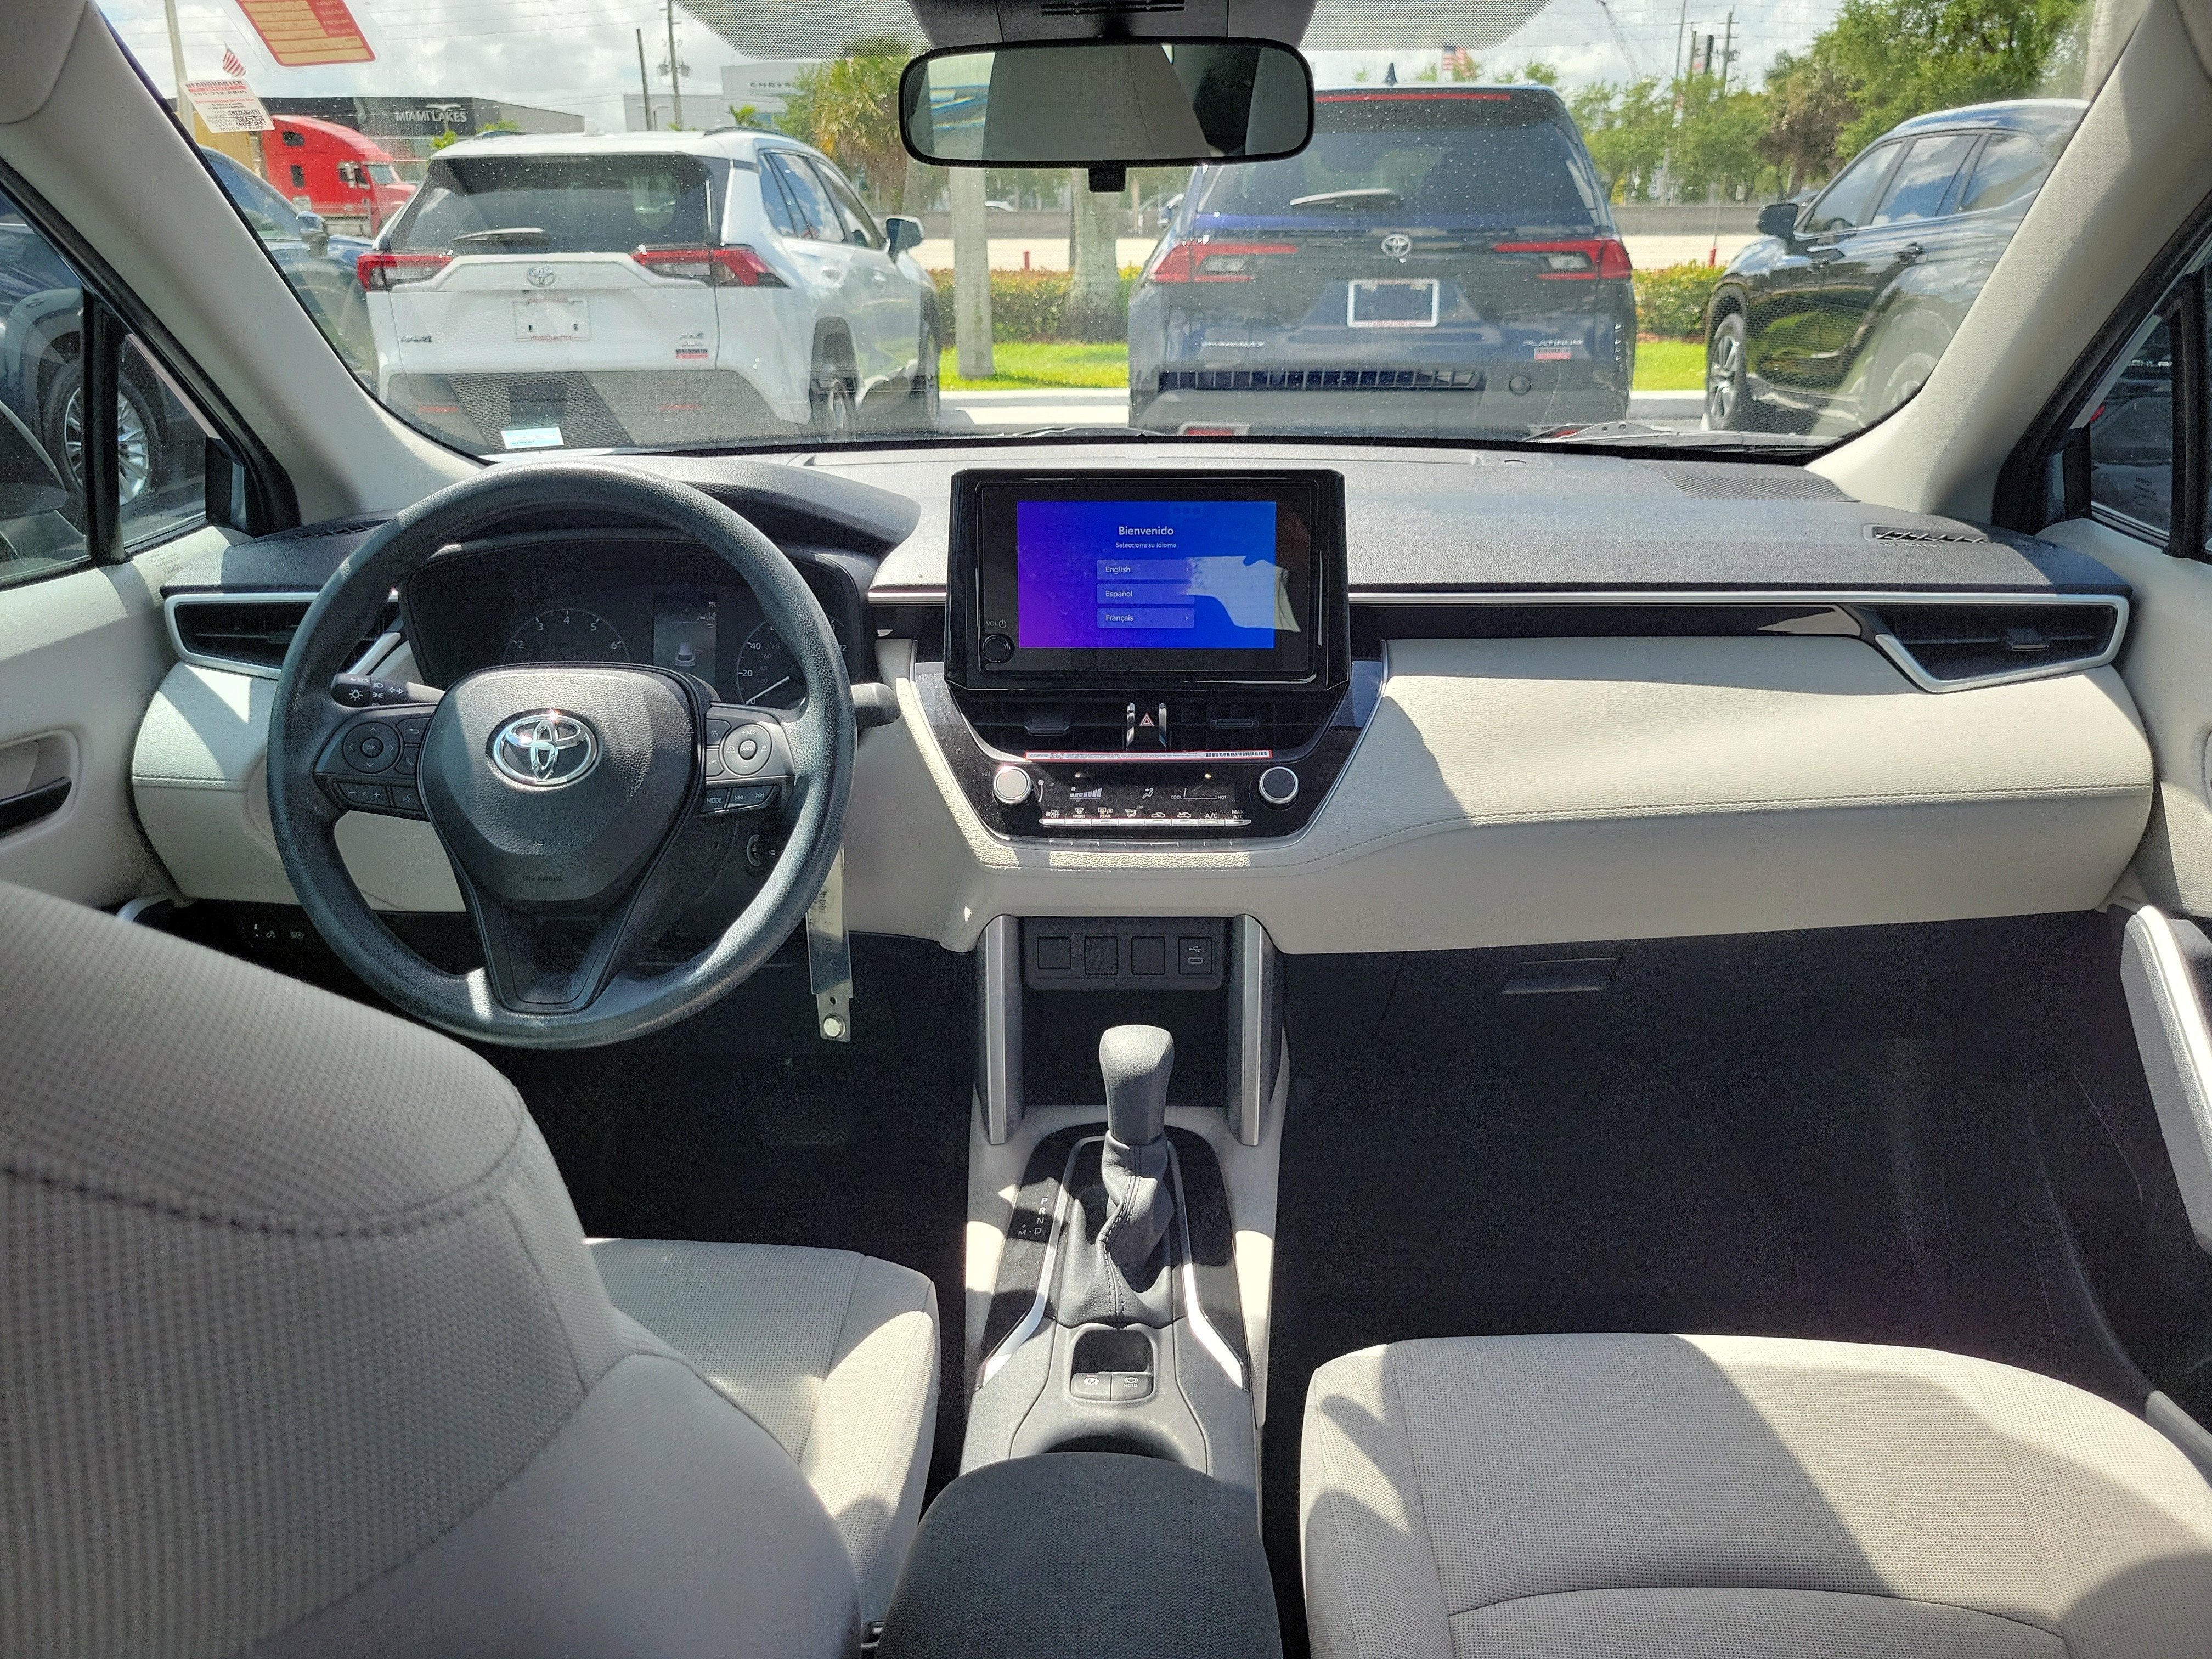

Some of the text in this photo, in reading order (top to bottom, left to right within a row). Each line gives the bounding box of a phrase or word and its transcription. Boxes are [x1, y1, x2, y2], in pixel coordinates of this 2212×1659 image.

[185, 81, 244, 89] HEADQUARTER
[396, 110, 467, 122] MIAMI LAKES
[1119, 526, 1175, 535] Bienvenido
[1105, 566, 1131, 574] English
[1105, 590, 1133, 599] Español
[1105, 614, 1134, 623] Français
[538, 623, 544, 631] 3
[591, 623, 597, 631] 5
[517, 640, 524, 649] 2
[611, 641, 618, 650] 6
